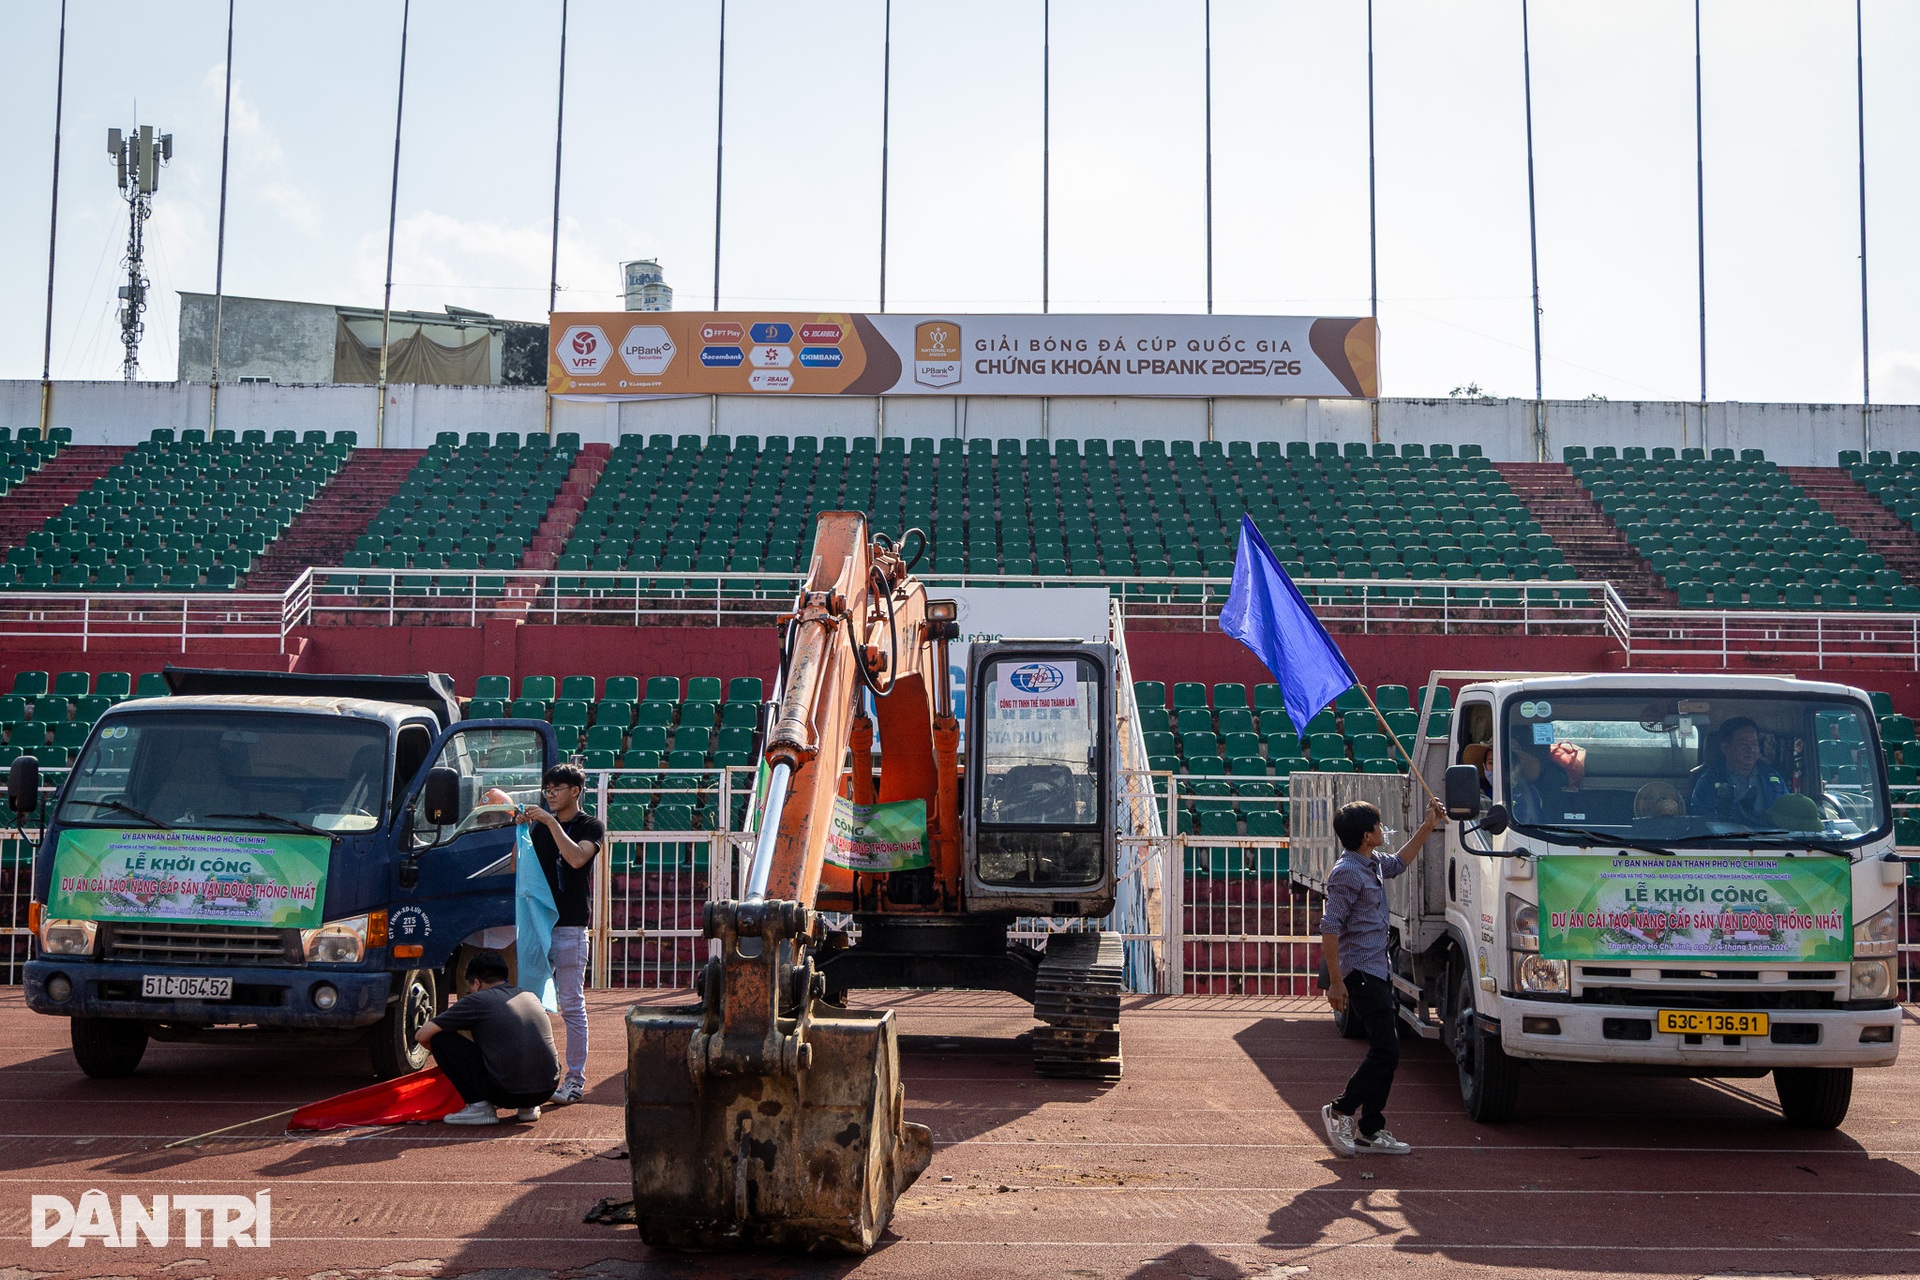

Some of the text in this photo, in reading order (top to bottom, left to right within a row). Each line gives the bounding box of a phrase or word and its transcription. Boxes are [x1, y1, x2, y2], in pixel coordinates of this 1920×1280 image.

[727, 330, 741, 338] Play
[975, 334, 1292, 352] GIẢI BÓNG ĐÁ CÚP QUỐC GIA
[626, 346, 662, 356] LPBank
[702, 352, 742, 361] Sacombank
[801, 353, 841, 361] EXIMBANK
[572, 358, 597, 368] VPF
[975, 355, 1302, 376] CHỨNG KHOÁN LPBANK 2025/26
[921, 366, 948, 375] LPBank
[1000, 698, 1011, 709] CÔNG
[1012, 700, 1019, 708] TY
[1019, 700, 1030, 708] TNHH
[1040, 699, 1050, 708] THAO
[835, 818, 864, 836] CÔNG
[132, 833, 146, 841] BAN
[247, 837, 266, 845] MINH
[871, 838, 899, 853] THỐNG
[900, 837, 921, 852] NHẤT
[125, 852, 252, 874] LỄ KHỞI CÔNG
[1624, 860, 1640, 868] BAN
[1642, 857, 1664, 868] NHÂN
[1757, 860, 1777, 869] MINH
[61, 877, 75, 895] DỰ
[76, 874, 88, 891] ÁN
[90, 874, 107, 892] CẢI
[159, 875, 179, 895] CẤP
[180, 878, 199, 896] SÂN
[201, 878, 222, 900] VẬN
[223, 880, 252, 900] ĐỘNG
[255, 880, 288, 899] THỐNG
[290, 881, 316, 900] NHẤT
[1625, 882, 1768, 903] LỄ KHỞI CÔNG
[403, 916, 416, 925] 2T5
[1551, 908, 1843, 934] DỰ ÁN CẢI TẠO, NÂNG CẤP SÂN VẬN ĐỘNG THỐNG NHẤT
[1771, 944, 1788, 952] 2026
[146, 978, 229, 996] 51C-054.52
[1668, 1014, 1758, 1031] 63C-136.91
